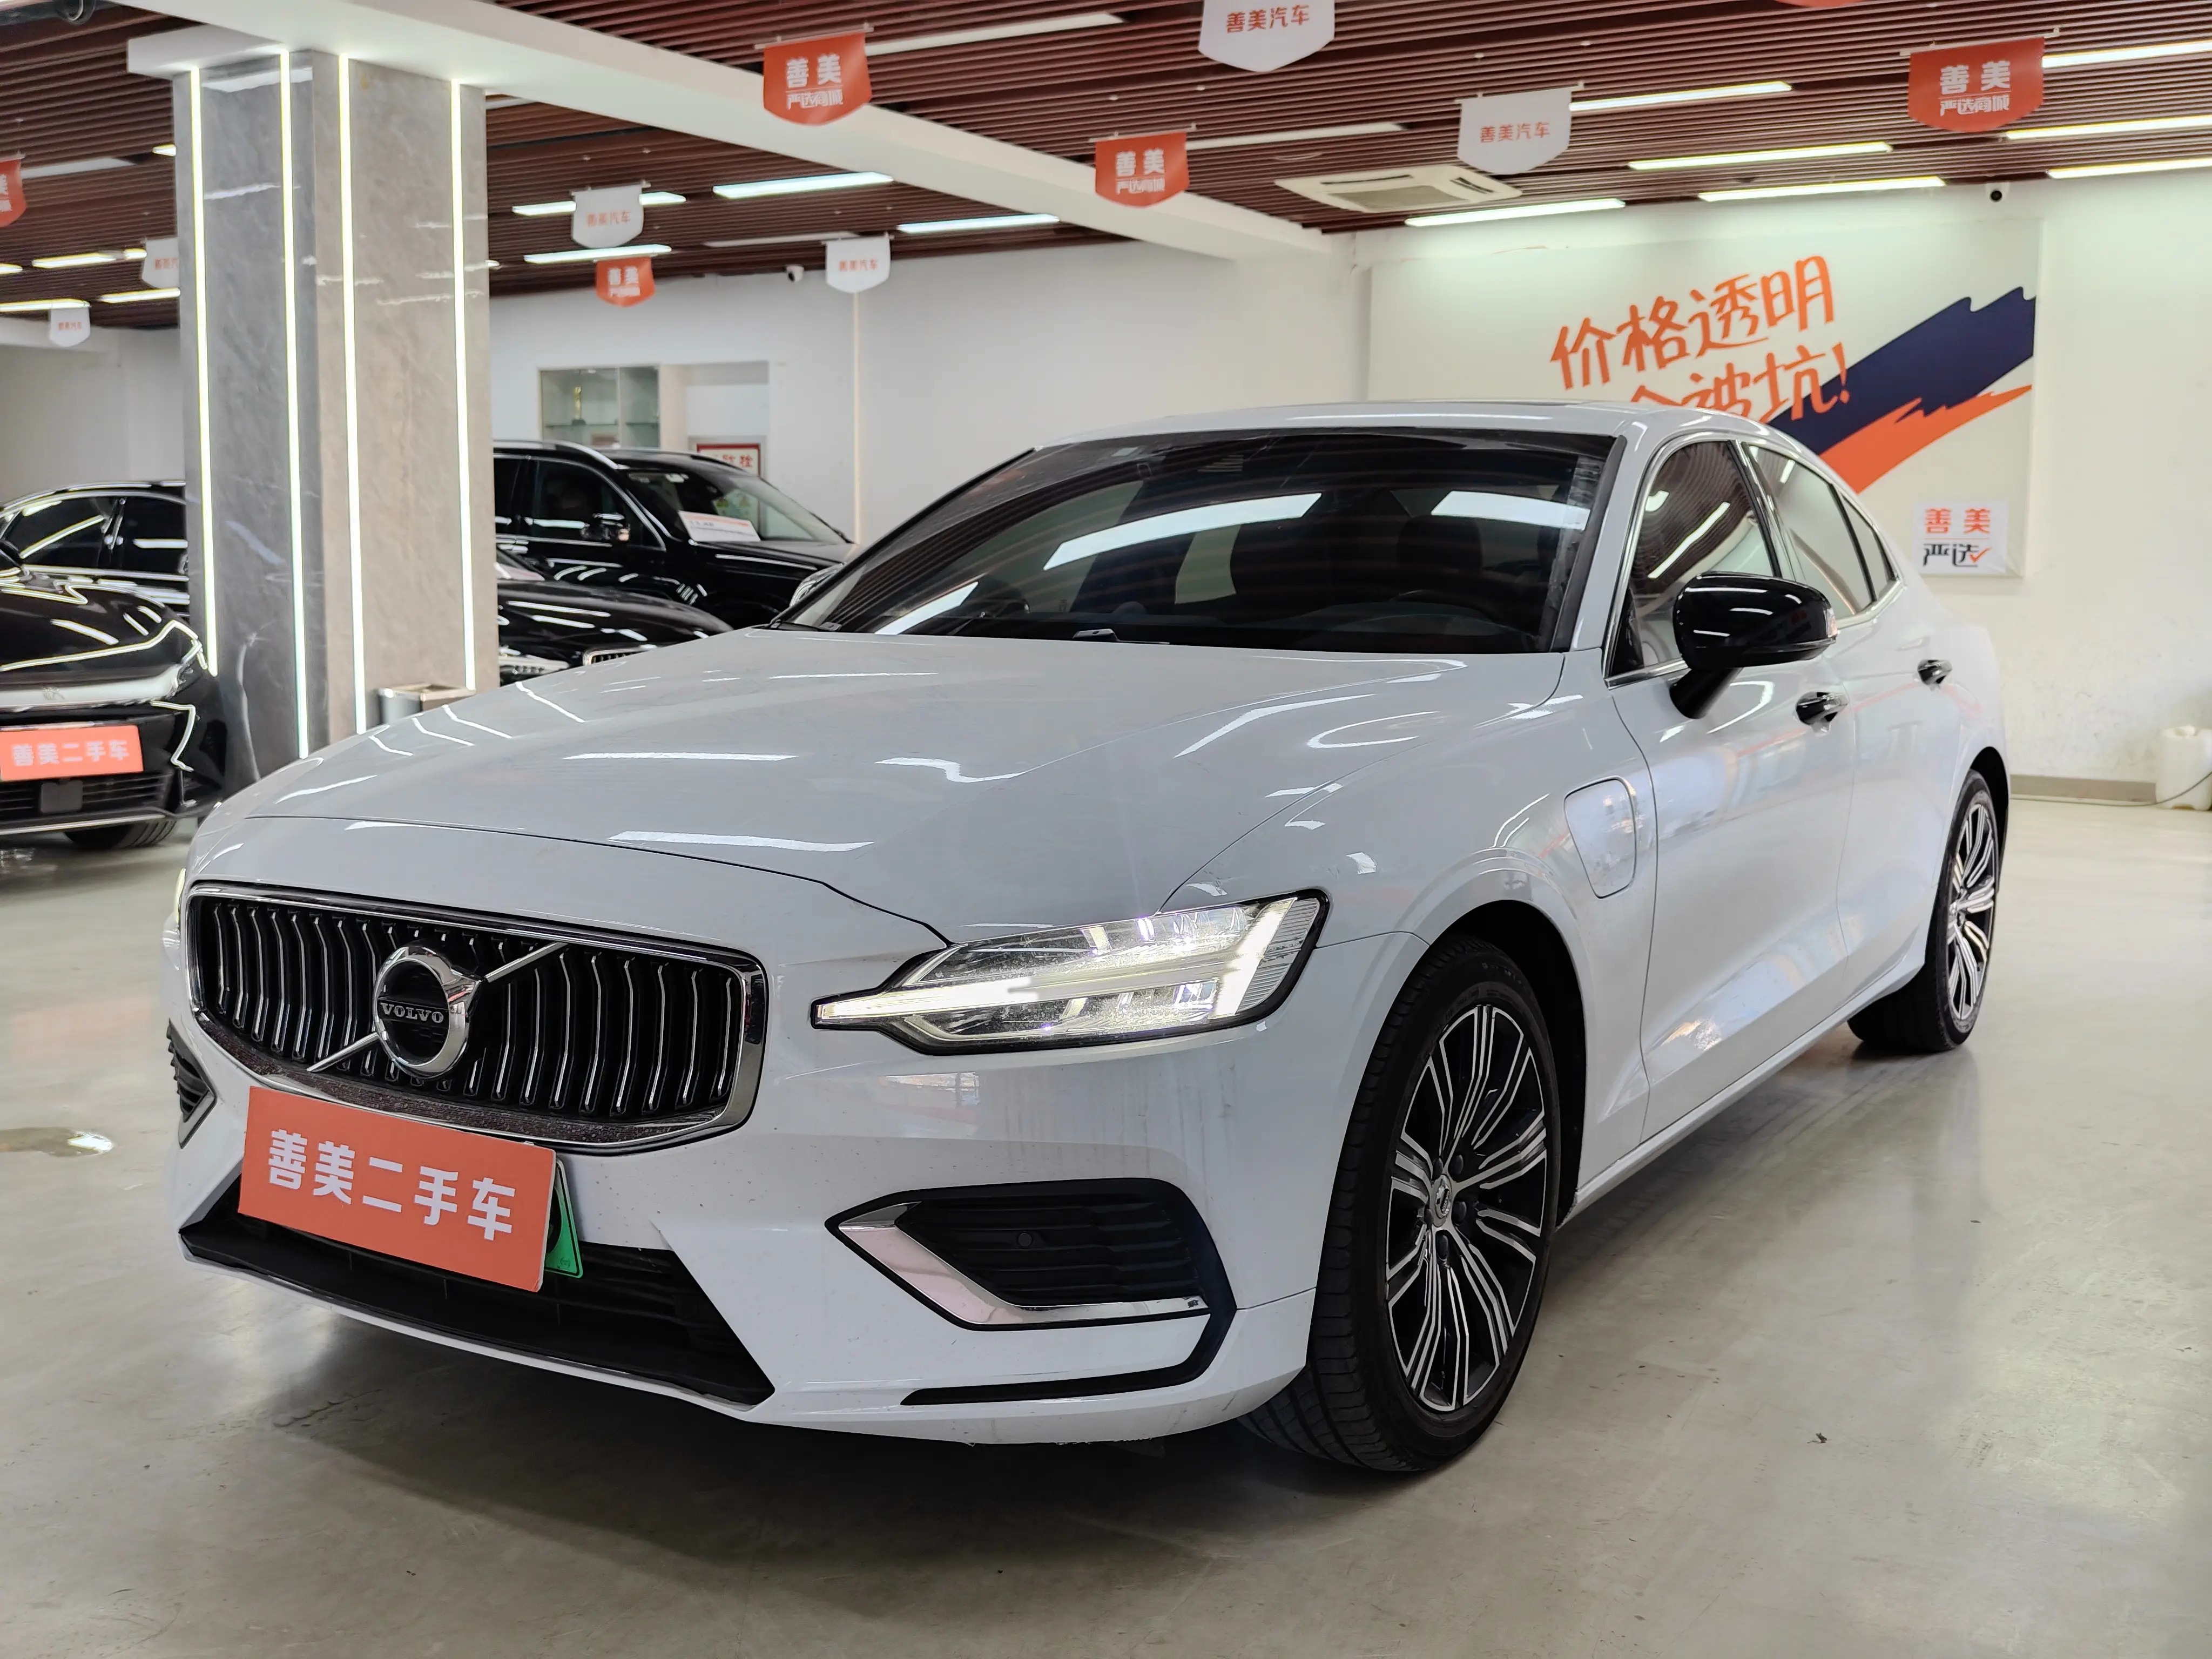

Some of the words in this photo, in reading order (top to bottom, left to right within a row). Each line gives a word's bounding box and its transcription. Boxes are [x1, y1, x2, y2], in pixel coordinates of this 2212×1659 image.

[1226, 4, 1310, 33] 善美汽车
[786, 53, 842, 88] 善美
[1940, 60, 2011, 95] 善美
[1480, 122, 1550, 143] 善美汽车
[1116, 147, 1165, 177] 善美
[1550, 254, 1835, 390] 价格透明
[1925, 507, 1990, 534] 善美
[1923, 543, 1992, 568] 严选
[12, 739, 129, 766] 善美二手车
[380, 1002, 444, 1023] VOLVO
[268, 1129, 516, 1240] 善美二手车
